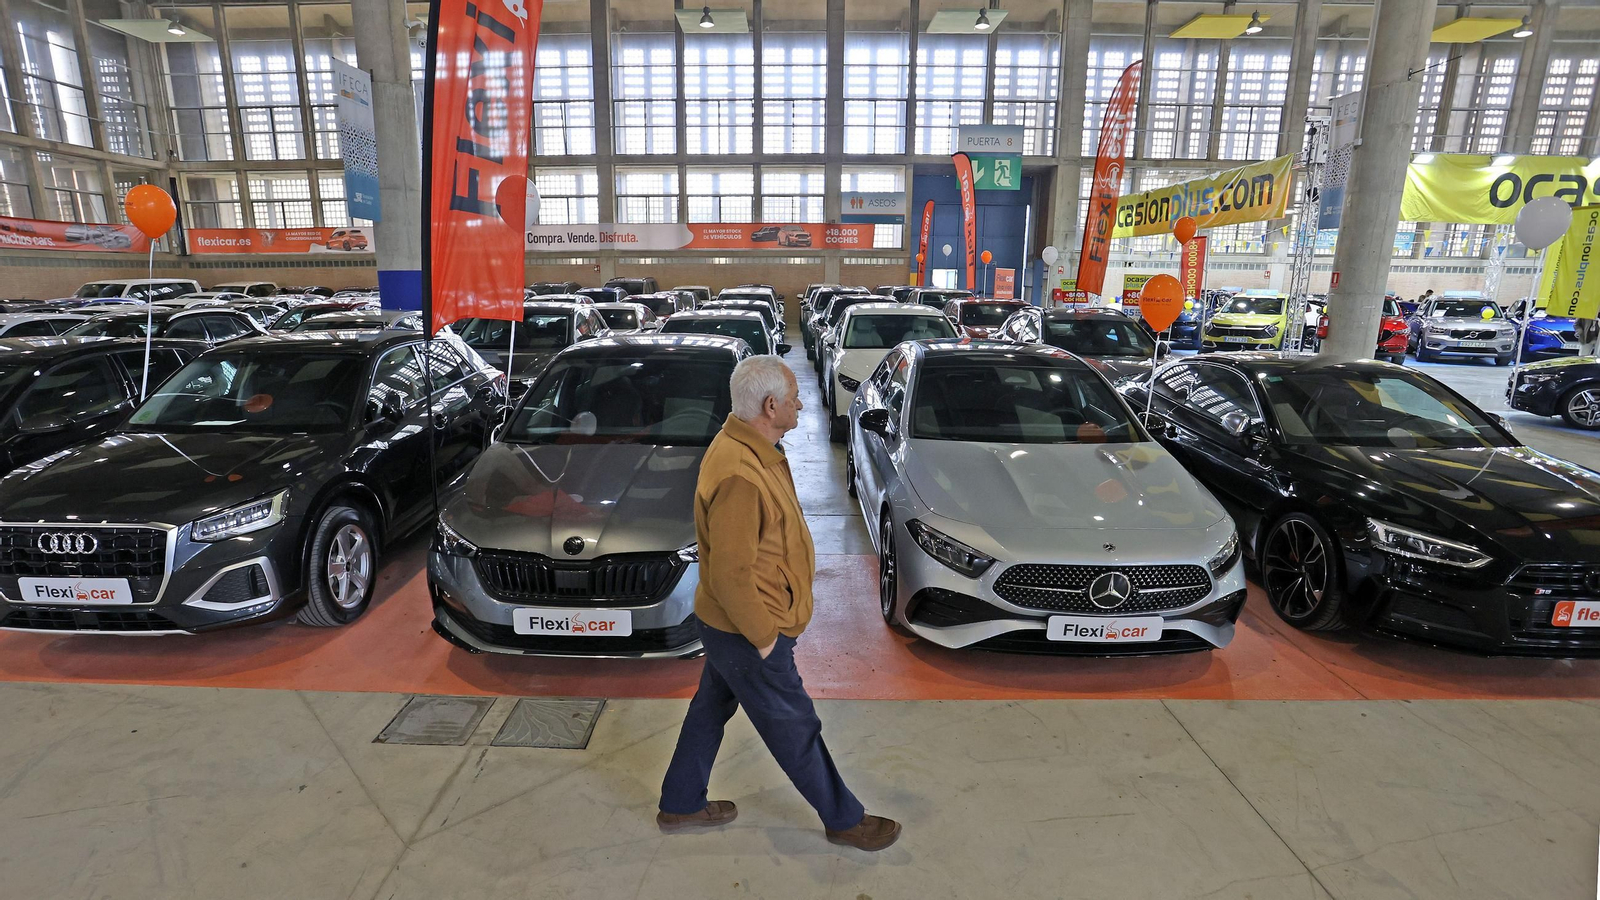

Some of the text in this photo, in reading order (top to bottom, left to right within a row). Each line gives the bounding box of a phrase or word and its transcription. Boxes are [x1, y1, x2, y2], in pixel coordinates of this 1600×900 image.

[339, 72, 368, 95] IFECA
[450, 3, 515, 218] Flexi
[967, 137, 1013, 146] PUERTA 8
[1108, 113, 1127, 160] car
[1489, 172, 1600, 209] oca
[868, 198, 897, 207] ASEOS
[1114, 173, 1275, 229] casionplus.com
[825, 228, 858, 236] +18.000
[1089, 192, 1113, 263] Flexi
[197, 236, 252, 246] flexicar.es
[527, 232, 638, 246] Compra. Vende. Disfruta.
[825, 236, 858, 244] COCHES
[34, 585, 116, 600] Flexi car
[1577, 607, 1600, 621] fle
[529, 616, 616, 631] Flexi car
[1063, 624, 1148, 638] Flexi car
